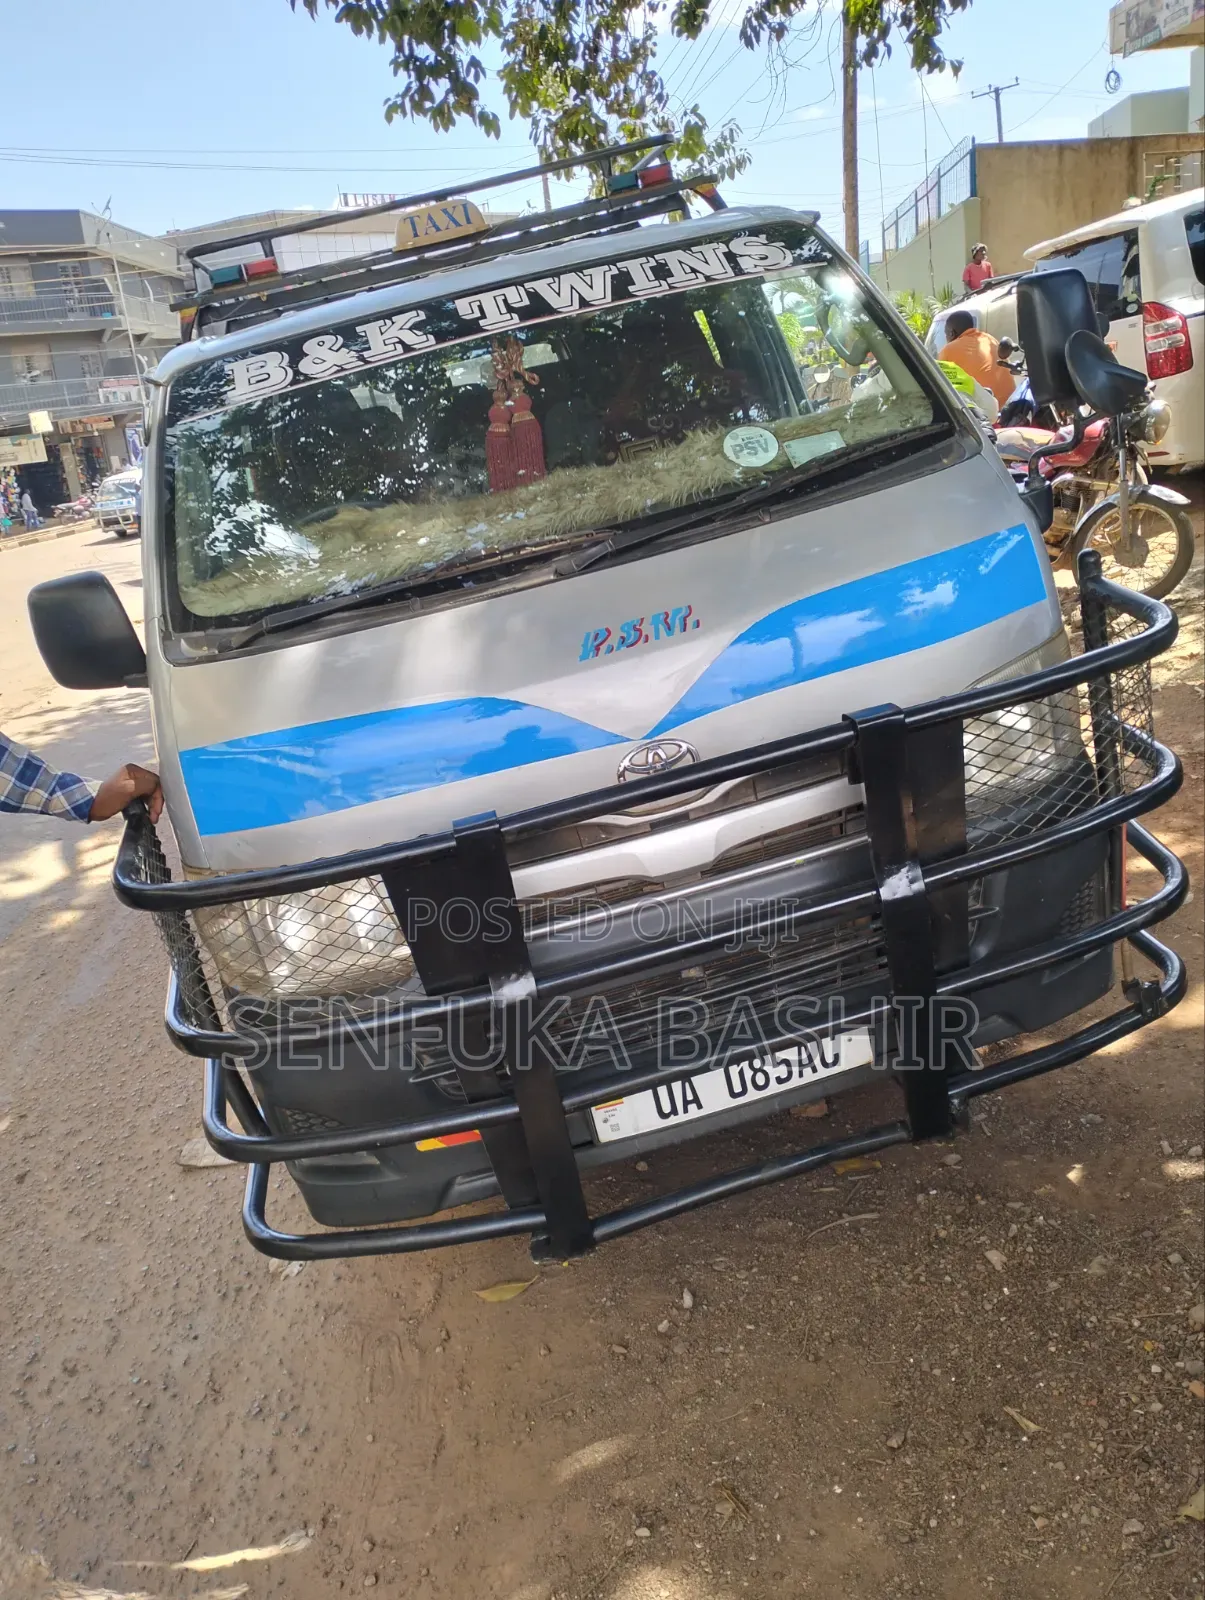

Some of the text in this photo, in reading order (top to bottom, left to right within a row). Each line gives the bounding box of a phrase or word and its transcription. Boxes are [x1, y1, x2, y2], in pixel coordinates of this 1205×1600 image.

[403, 203, 472, 238] TAXI
[222, 233, 793, 403] B&K TWINS
[730, 437, 770, 460] PSV
[652, 1077, 703, 1120] UA
